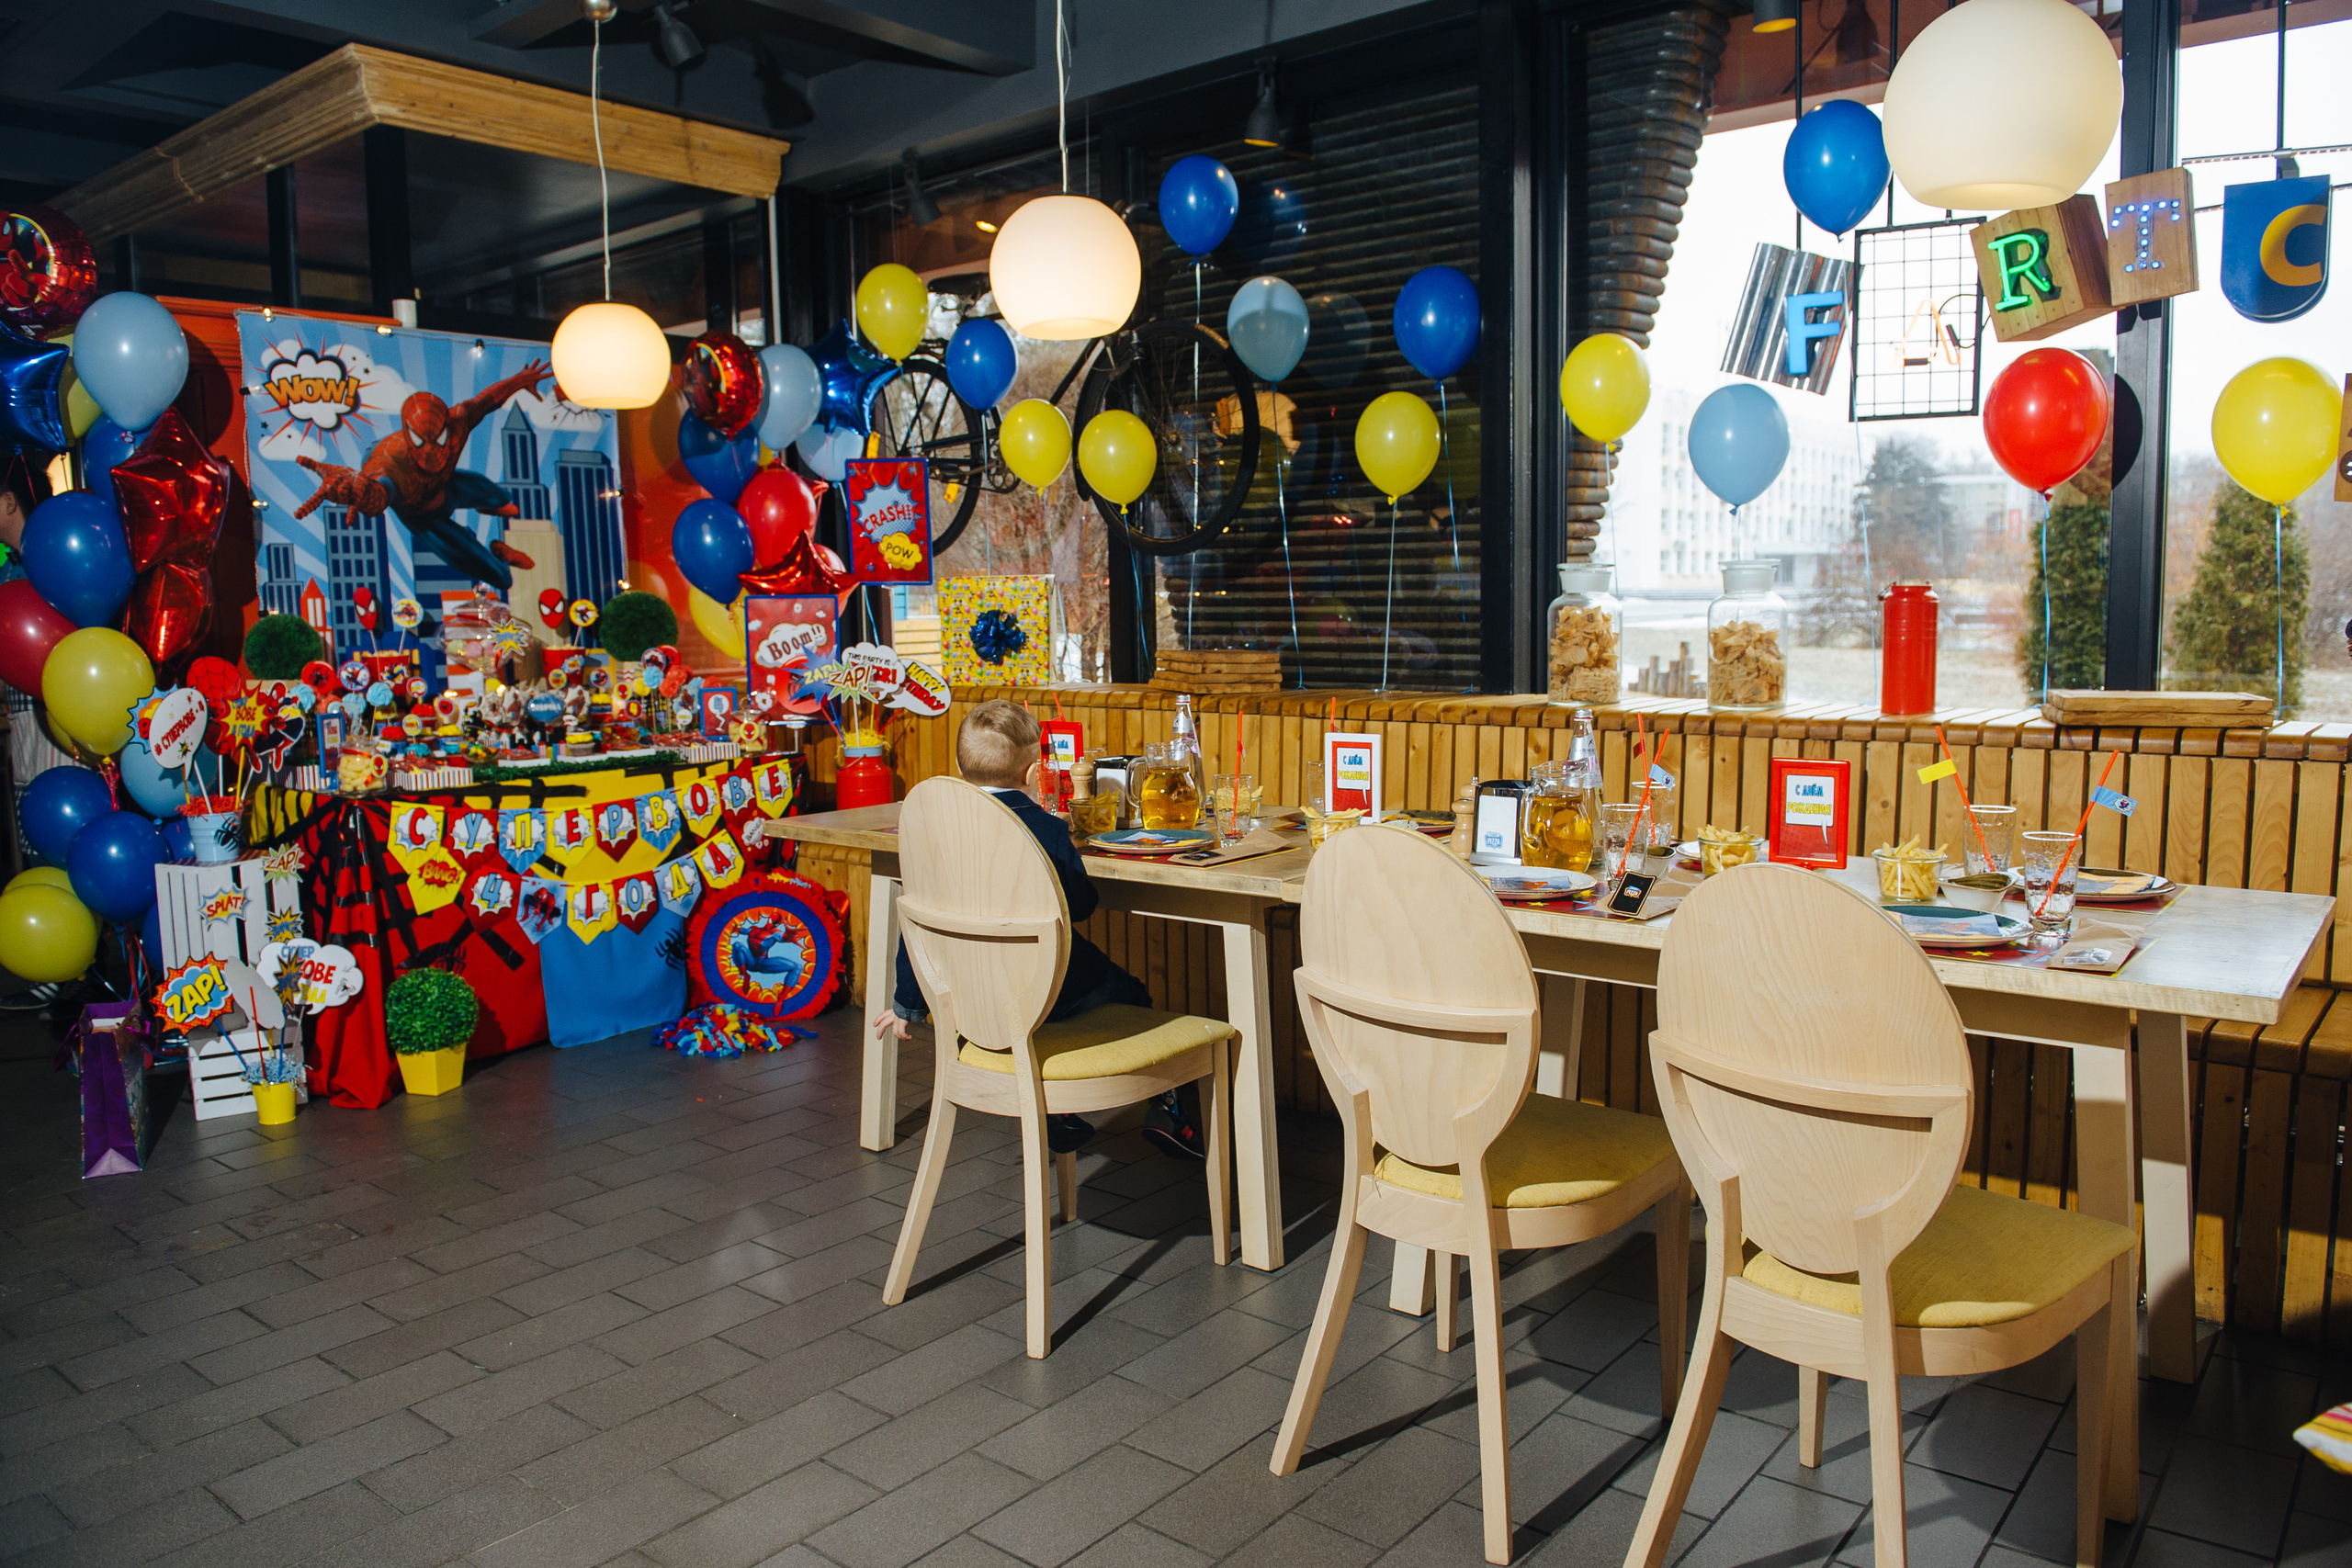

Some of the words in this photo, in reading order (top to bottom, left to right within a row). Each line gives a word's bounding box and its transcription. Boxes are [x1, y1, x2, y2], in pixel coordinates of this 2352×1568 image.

[263, 375, 360, 408] WOW!
[863, 503, 917, 534] CRASH!!
[886, 542, 914, 559] POW
[863, 655, 883, 663] PARTY
[830, 664, 871, 691] ZAP!
[906, 661, 945, 693] HAPPY
[1795, 784, 1801, 795] С
[266, 851, 299, 873] ZAP!
[423, 863, 462, 884] BANG!
[206, 895, 246, 918] SPLAT!
[298, 957, 336, 985] ОВЕ
[164, 964, 227, 1023] ZAP!
